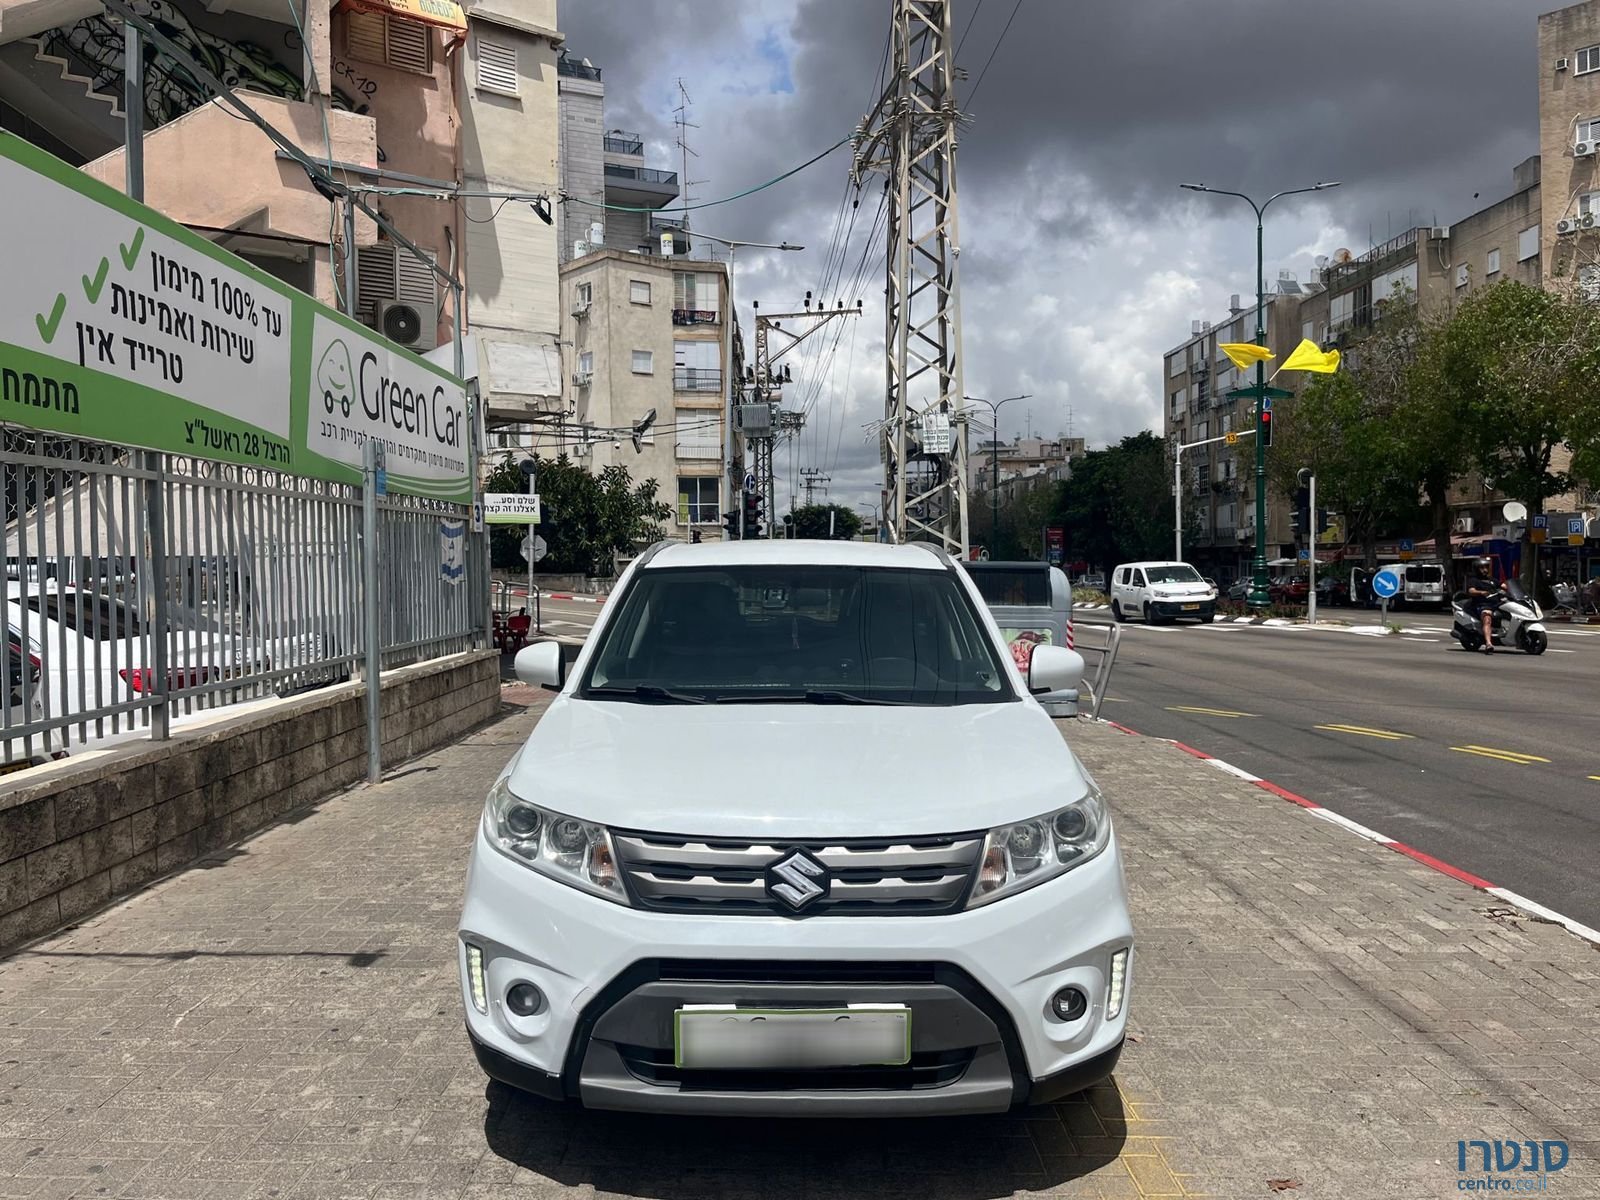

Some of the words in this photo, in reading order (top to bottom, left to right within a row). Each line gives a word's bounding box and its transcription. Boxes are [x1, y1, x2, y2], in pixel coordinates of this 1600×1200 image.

[151, 251, 204, 303] מימון
[111, 282, 195, 343] ואמינות
[210, 277, 258, 327] 100%
[261, 306, 282, 337] עד
[76, 321, 115, 367] אין
[201, 320, 254, 364] שירות
[122, 336, 183, 384] טרייד
[359, 351, 428, 438] Green
[432, 385, 462, 448] Car
[243, 432, 260, 458] 28
[320, 421, 338, 440] רכב
[340, 429, 368, 451] לקניית
[1227, 434, 1236, 442] 13
[261, 435, 291, 465] הרצל
[398, 444, 427, 465] מתקדמים
[513, 504, 536, 513] אצלנו
[517, 496, 536, 504] שלם
